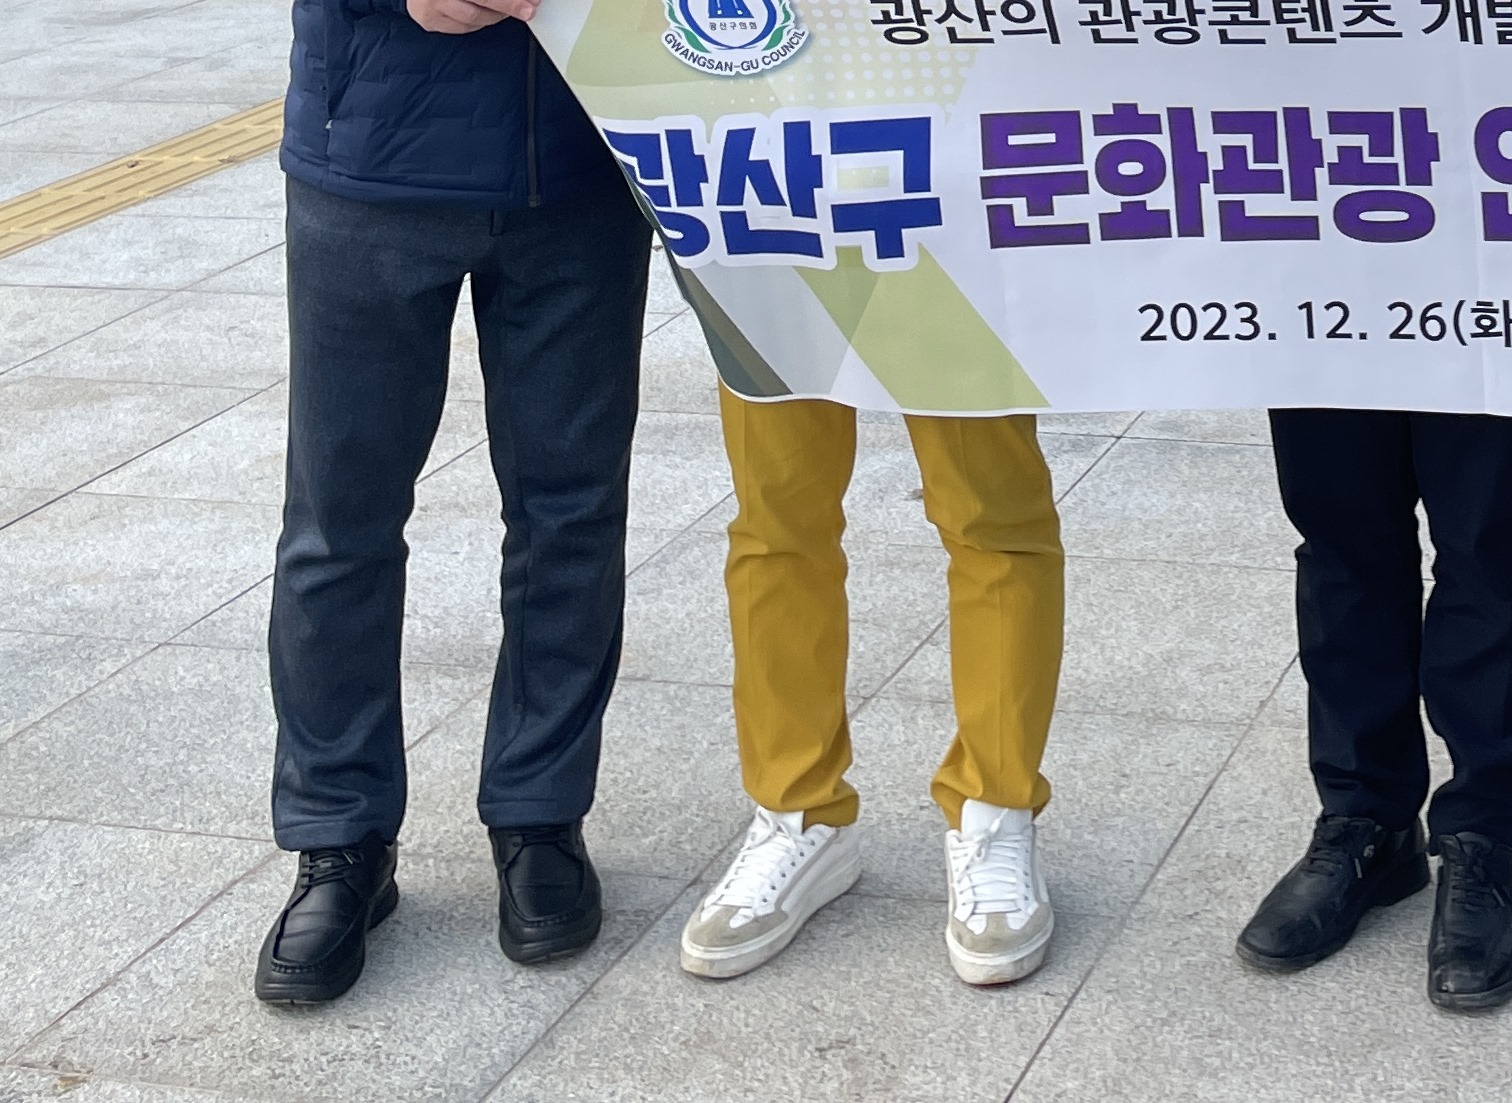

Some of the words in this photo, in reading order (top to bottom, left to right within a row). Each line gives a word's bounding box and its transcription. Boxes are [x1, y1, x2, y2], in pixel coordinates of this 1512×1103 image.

[664, 32, 759, 73] GWANGSAN-GU
[761, 29, 806, 66] COUNCIL
[602, 116, 942, 260] 광산구
[979, 103, 1440, 249] 문화관광
[1137, 301, 1277, 342] 2023.
[1297, 300, 1369, 341] 12.
